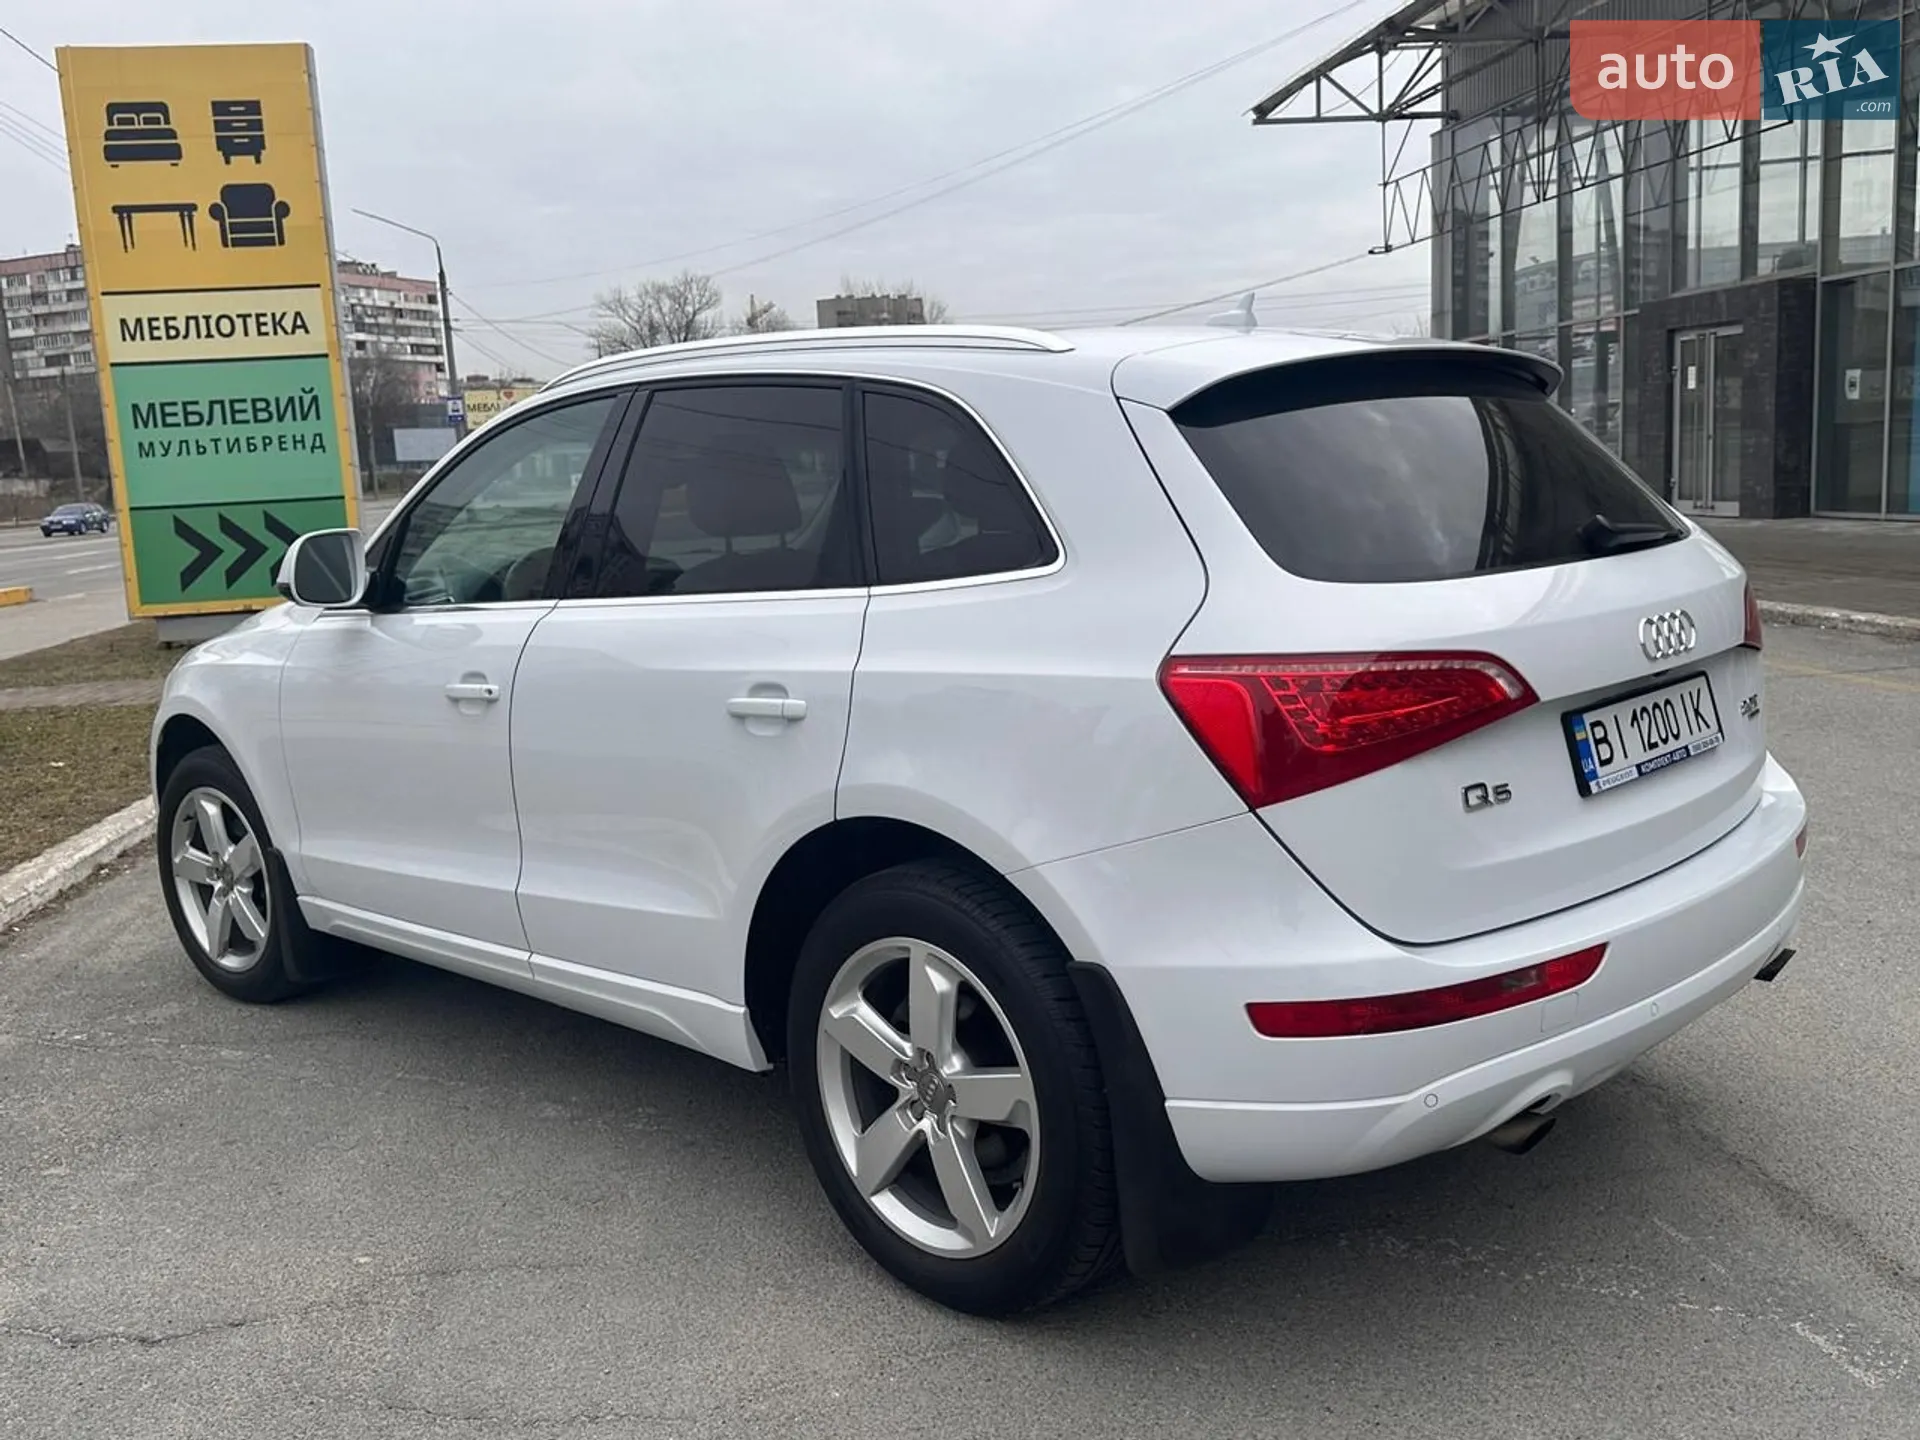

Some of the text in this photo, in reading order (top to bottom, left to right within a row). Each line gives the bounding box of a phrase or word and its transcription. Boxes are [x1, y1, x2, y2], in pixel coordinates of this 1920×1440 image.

[119, 311, 310, 342] МЕБЛІОТЕКА
[131, 387, 321, 429] МЕБЛЕВИЙ
[138, 433, 326, 458] МУЛЬТИБРЕНД
[1589, 714, 1628, 767] BI
[1630, 697, 1681, 753] 1200
[1680, 687, 1711, 737] IK
[1581, 759, 1596, 773] UA
[1461, 782, 1512, 813] Q5
